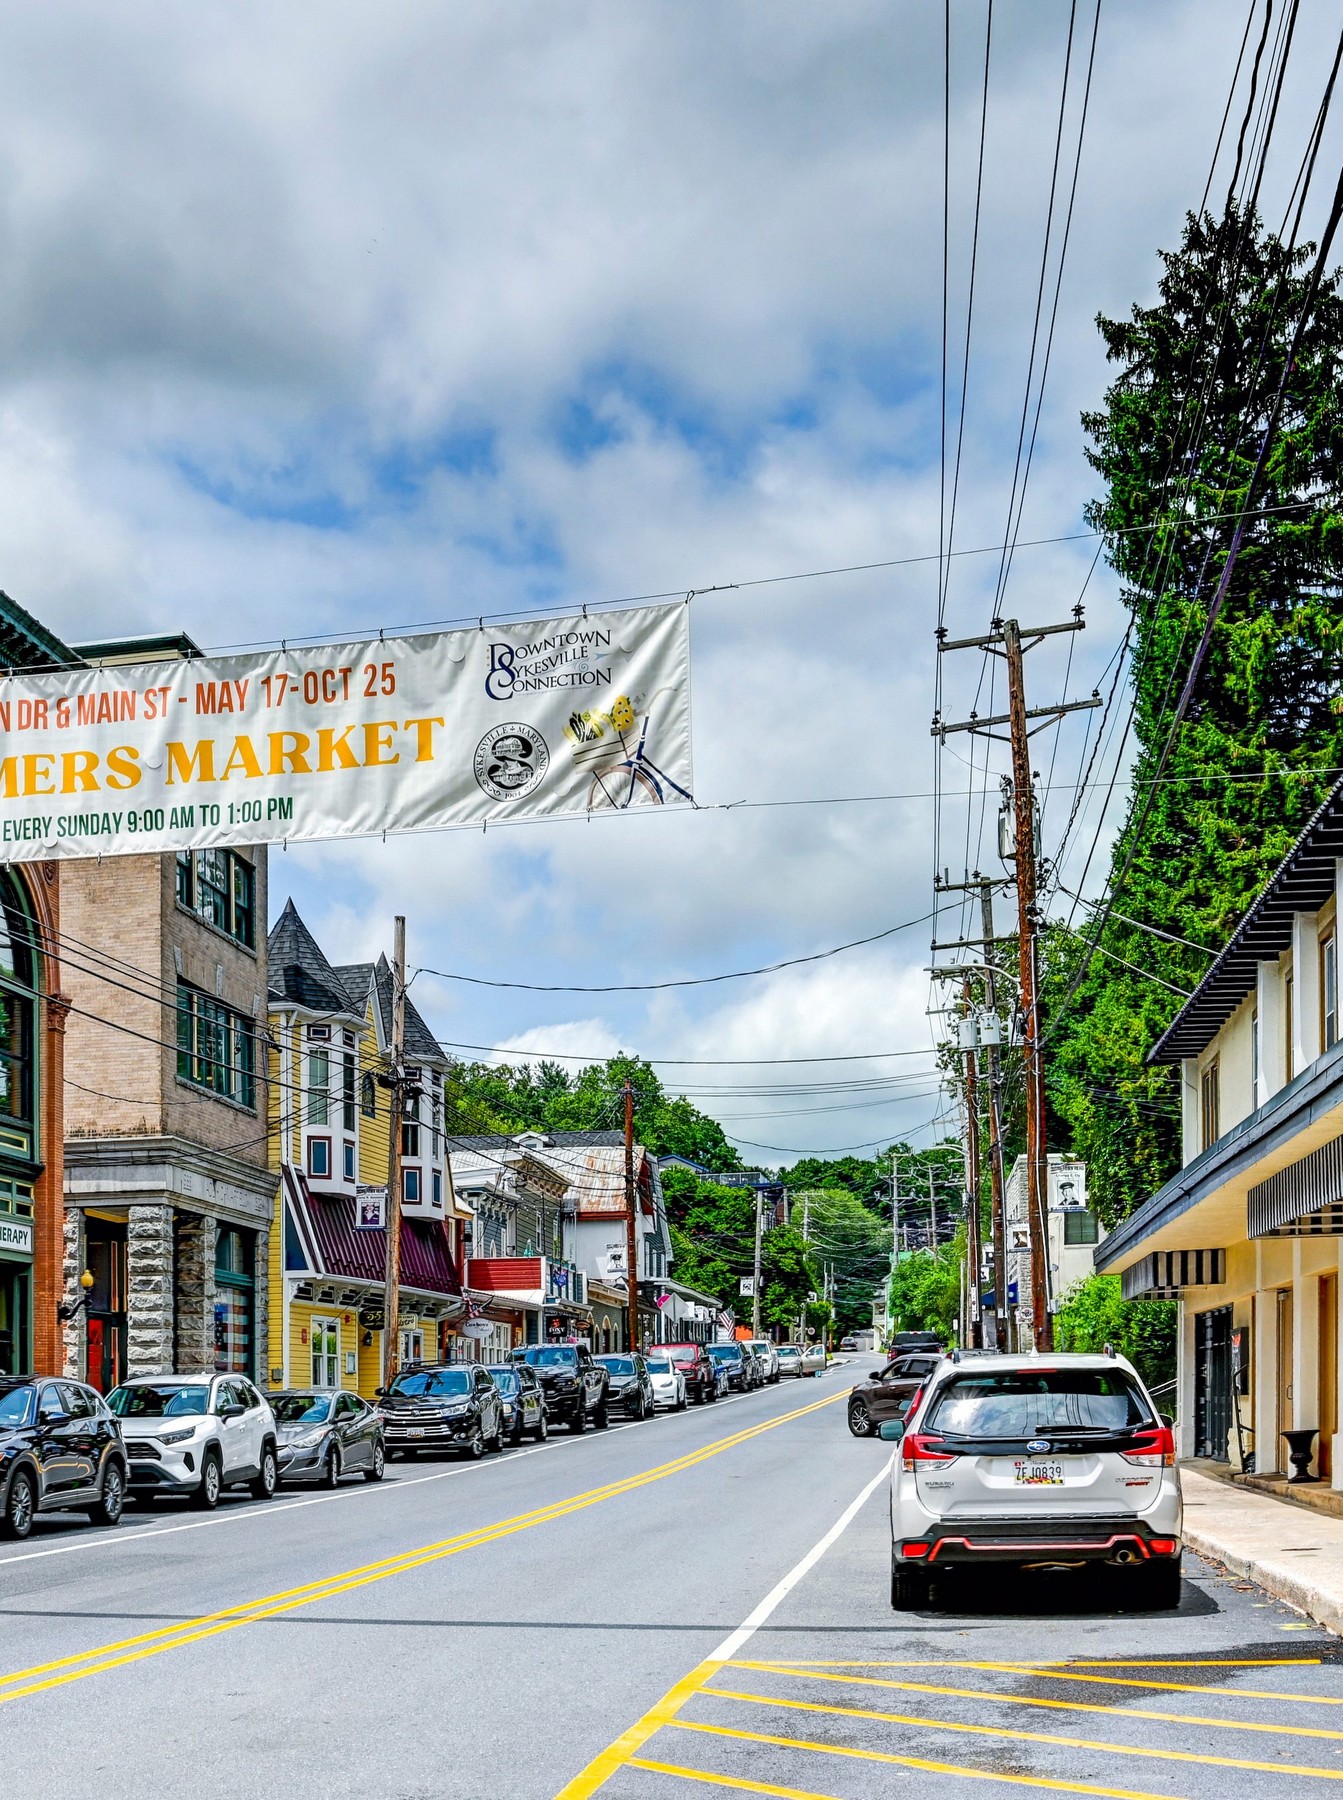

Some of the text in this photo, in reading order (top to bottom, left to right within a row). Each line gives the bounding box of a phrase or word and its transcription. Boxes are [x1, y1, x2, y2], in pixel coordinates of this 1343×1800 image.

[488, 629, 611, 672] DOWNTOWN
[497, 646, 588, 688] SYKESVILLE
[17, 698, 49, 730] DR
[56, 697, 71, 729] &
[77, 690, 137, 727] MAIN
[143, 686, 172, 725] ST
[195, 679, 249, 714] MAY
[260, 667, 353, 708] 17-OCT
[363, 662, 396, 697] 25
[485, 668, 612, 700] CONNECTION
[165, 717, 445, 785] MARKET
[476, 726, 508, 777] SYKESVILLE
[517, 726, 546, 770] MARYLAND
[3, 796, 294, 842] EVERY SUNDAY 9:00 AM TO 1:00 PM
